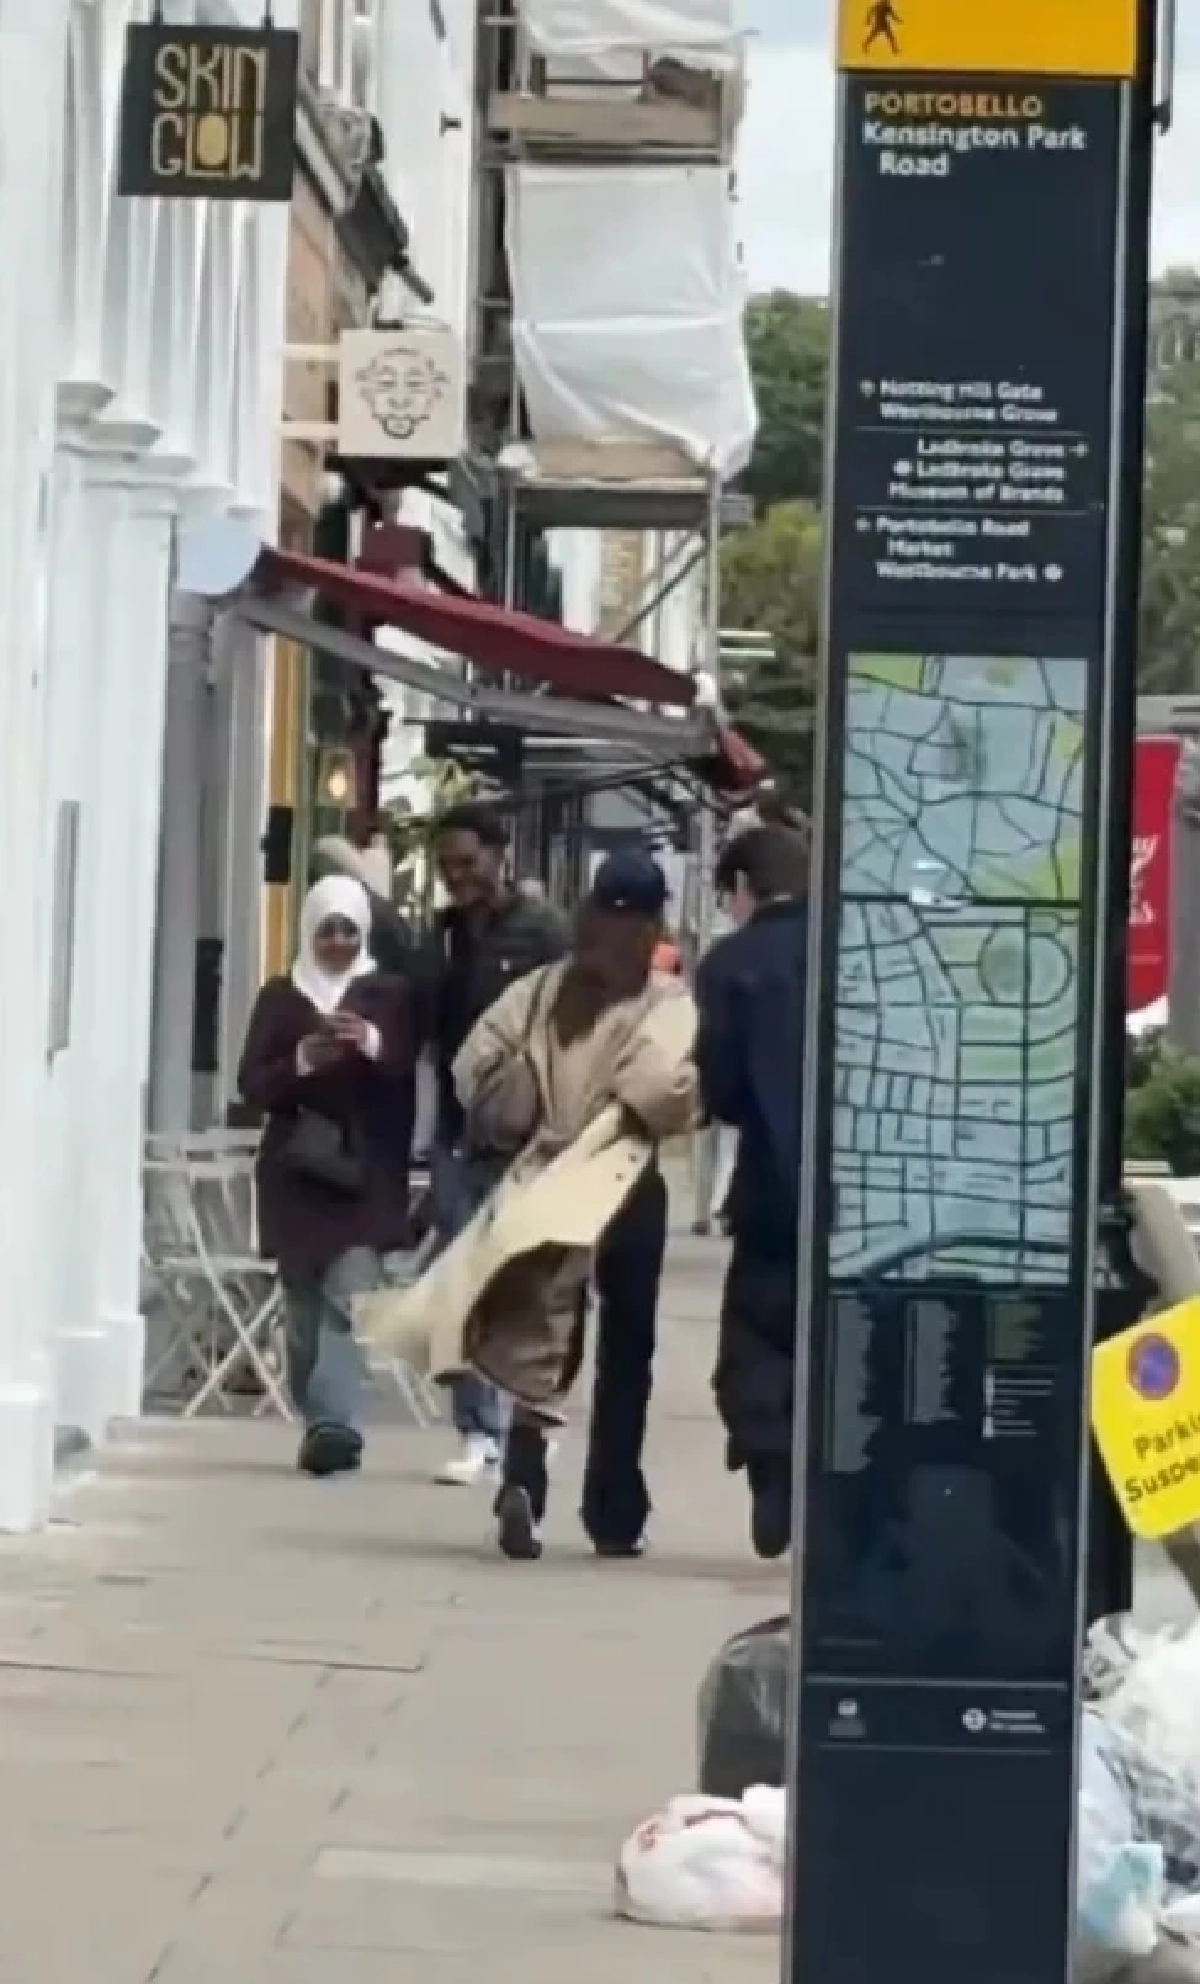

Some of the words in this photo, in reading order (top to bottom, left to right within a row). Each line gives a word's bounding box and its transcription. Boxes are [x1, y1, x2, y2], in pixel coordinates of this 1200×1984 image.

[154, 43, 267, 108] SKIN
[863, 91, 1043, 118] PORTOBELLO
[152, 112, 264, 179] GLOW
[862, 121, 1020, 151] Kensington
[1026, 124, 1087, 150] Park
[879, 150, 950, 176] Road
[880, 380, 955, 402] Notting
[958, 381, 993, 399] Hill
[997, 381, 1043, 401] Gate
[880, 402, 996, 421] Westbourne
[1000, 403, 1058, 422] Grove
[917, 437, 1005, 457] Ladbroke
[1009, 439, 1066, 458] Grove
[917, 460, 1005, 479] Ladbroke
[1008, 461, 1066, 481] Grove
[888, 483, 969, 500] Museum
[973, 483, 996, 500] of
[876, 515, 978, 535] Portobello
[981, 517, 1031, 537] Road
[887, 538, 955, 557] Market
[876, 561, 993, 580] Westbourne
[996, 562, 1037, 582] Park
[1133, 1411, 1200, 1461] Parki
